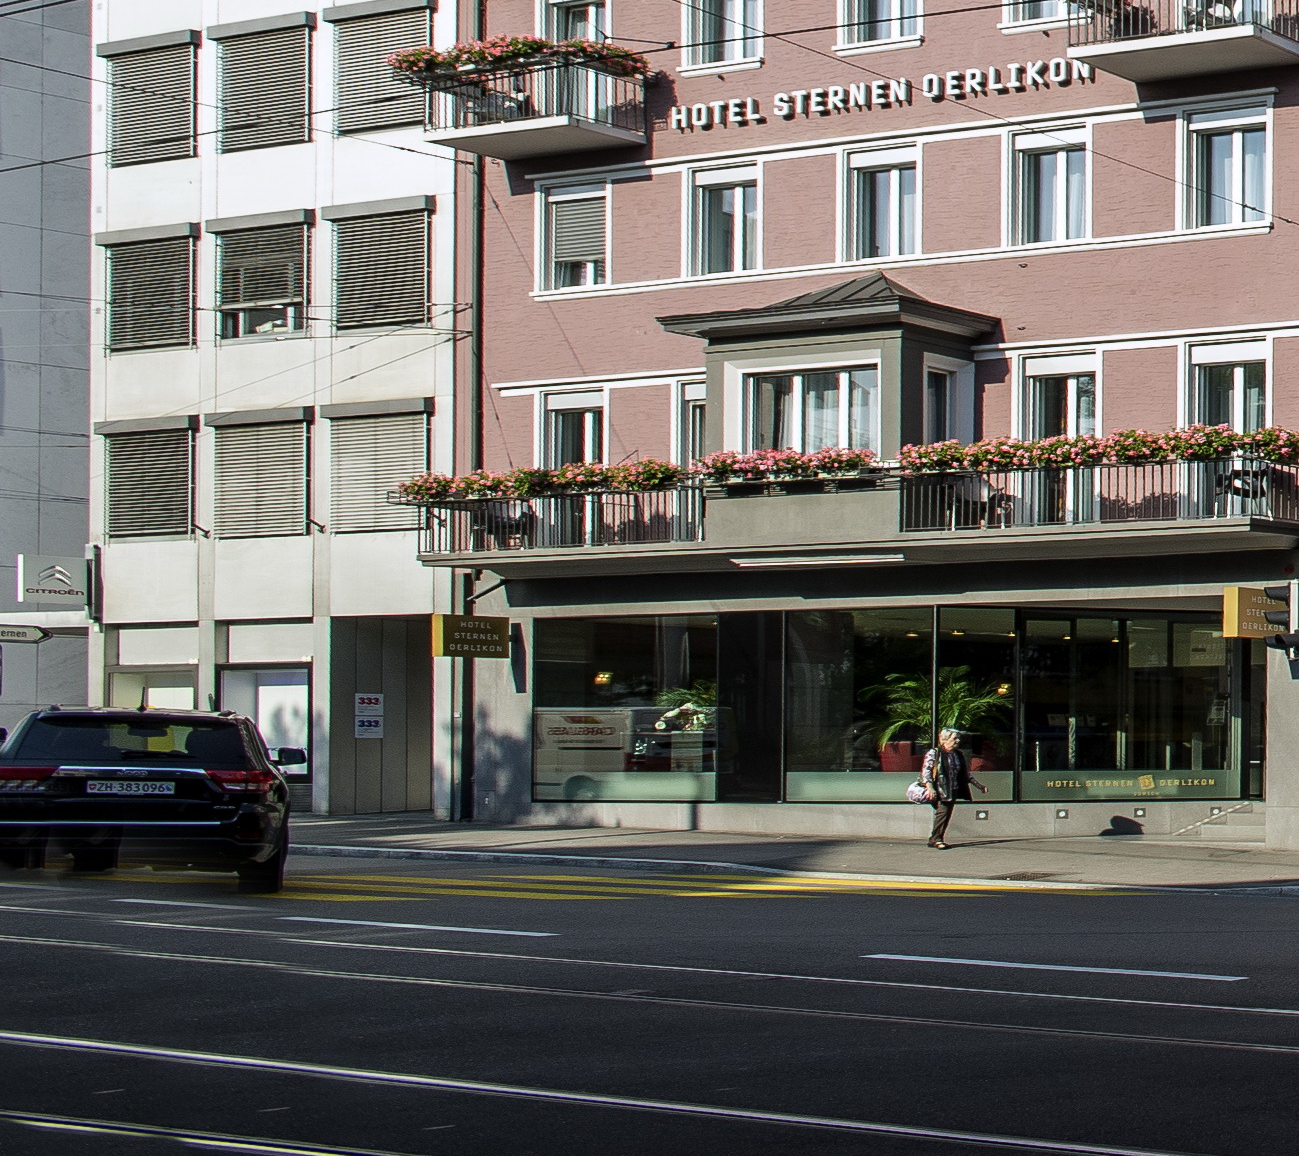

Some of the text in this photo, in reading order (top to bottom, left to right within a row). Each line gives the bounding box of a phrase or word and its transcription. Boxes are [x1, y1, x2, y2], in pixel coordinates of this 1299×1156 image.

[671, 57, 1095, 131] HOTEL STERNEN OERLIKON
[460, 621, 492, 629] HOTEL
[454, 632, 499, 641] STERNEN
[449, 644, 503, 652] OERLIKON
[1046, 778, 1215, 788] HOTEL STERNEN OERLIKON
